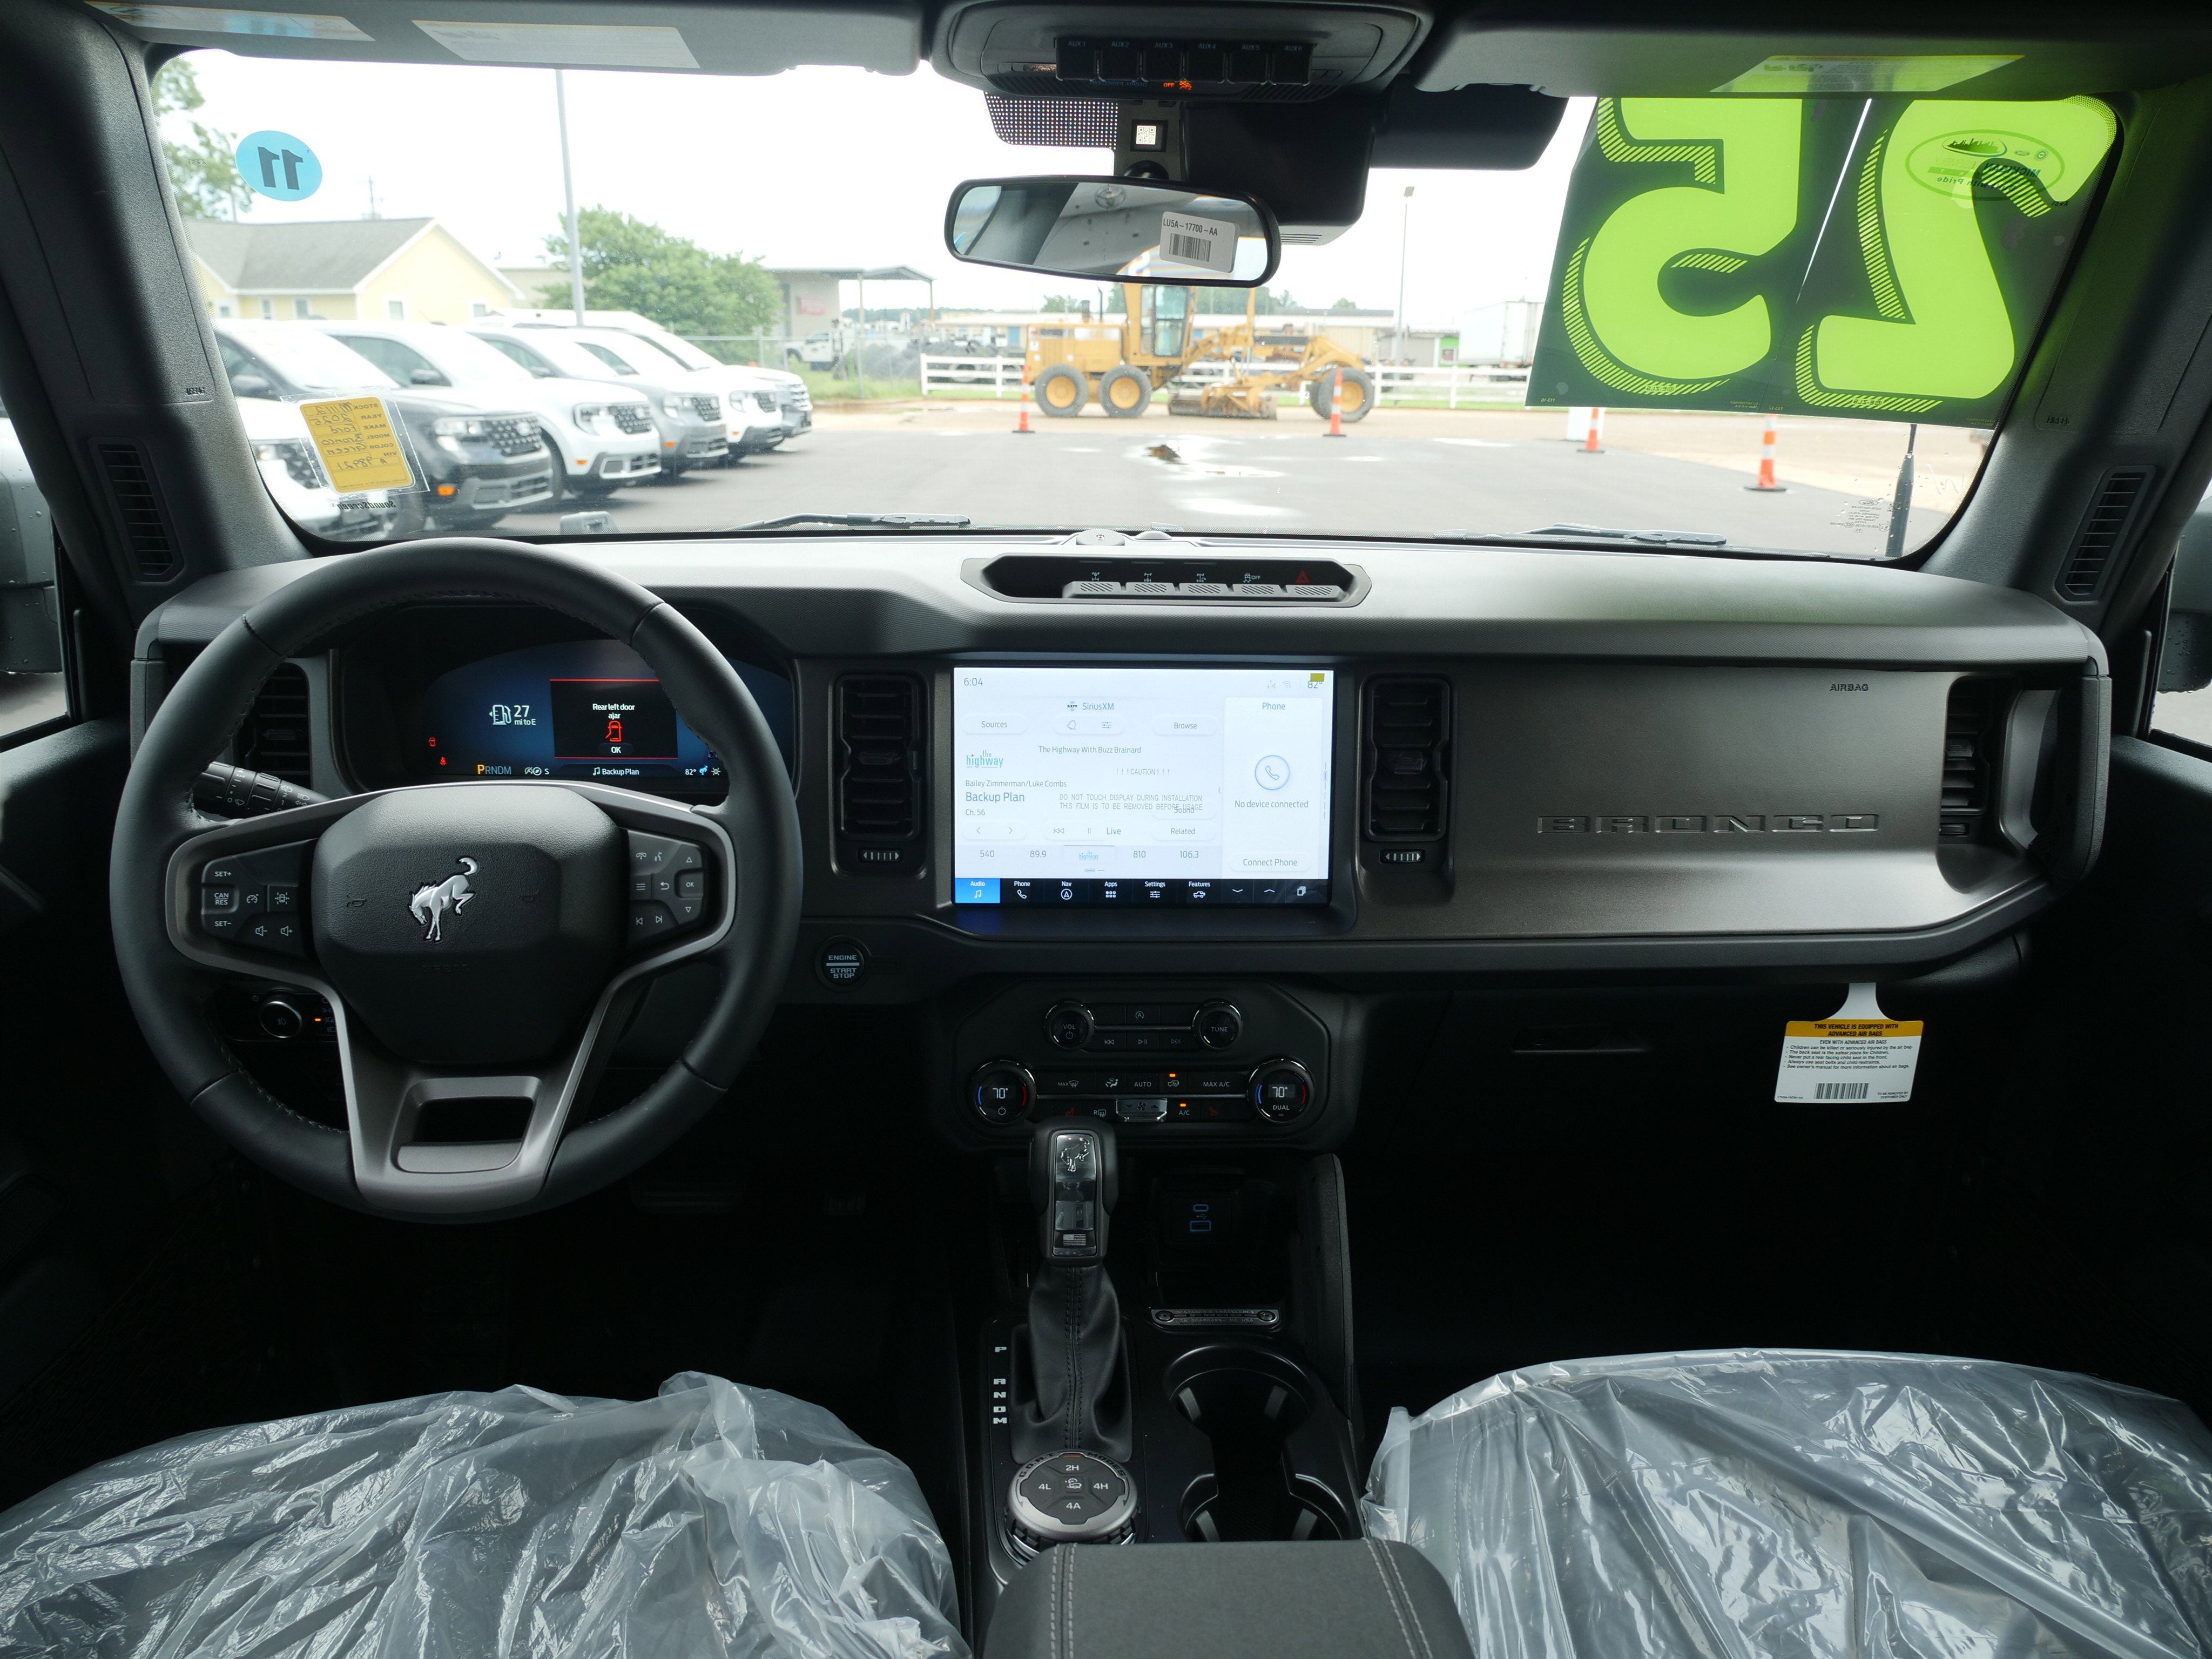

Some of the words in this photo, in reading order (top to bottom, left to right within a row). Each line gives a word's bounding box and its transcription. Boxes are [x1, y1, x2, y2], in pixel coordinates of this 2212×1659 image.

[1185, 222, 1203, 233] 17700
[963, 677, 983, 686] 6:04
[1830, 683, 1869, 692] AIRBAG
[1082, 703, 1114, 711] SiriusXM
[1262, 702, 1286, 710] Phone
[514, 706, 529, 717] 27
[608, 712, 621, 720] ajar
[981, 720, 1008, 729] Sources
[1038, 746, 1050, 754] The
[1052, 746, 1080, 757] Highway
[1082, 746, 1097, 754] With
[1098, 747, 1112, 755] Buzz
[1114, 747, 1141, 755] Brainard
[966, 754, 1003, 767] highway
[602, 768, 621, 777] Backup
[966, 780, 984, 791] Bailey
[987, 780, 1043, 788] Zimmerman/Luke
[966, 792, 1001, 804] Backup
[1003, 793, 1025, 802] Plan
[1537, 814, 1878, 833] BRONCO
[1107, 827, 1121, 835] Live
[1171, 827, 1196, 835] Related
[980, 850, 995, 858] 540
[1030, 850, 1047, 858] 89.9
[1078, 853, 1099, 861] highway
[1133, 850, 1146, 858] 810
[1179, 850, 1199, 858] 106.3
[1243, 858, 1273, 866] Connect
[1275, 858, 1298, 866] Phone
[992, 1087, 1009, 1100] 70°
[1272, 1087, 1289, 1099] 70°
[1087, 1452, 1126, 1476] MODES
